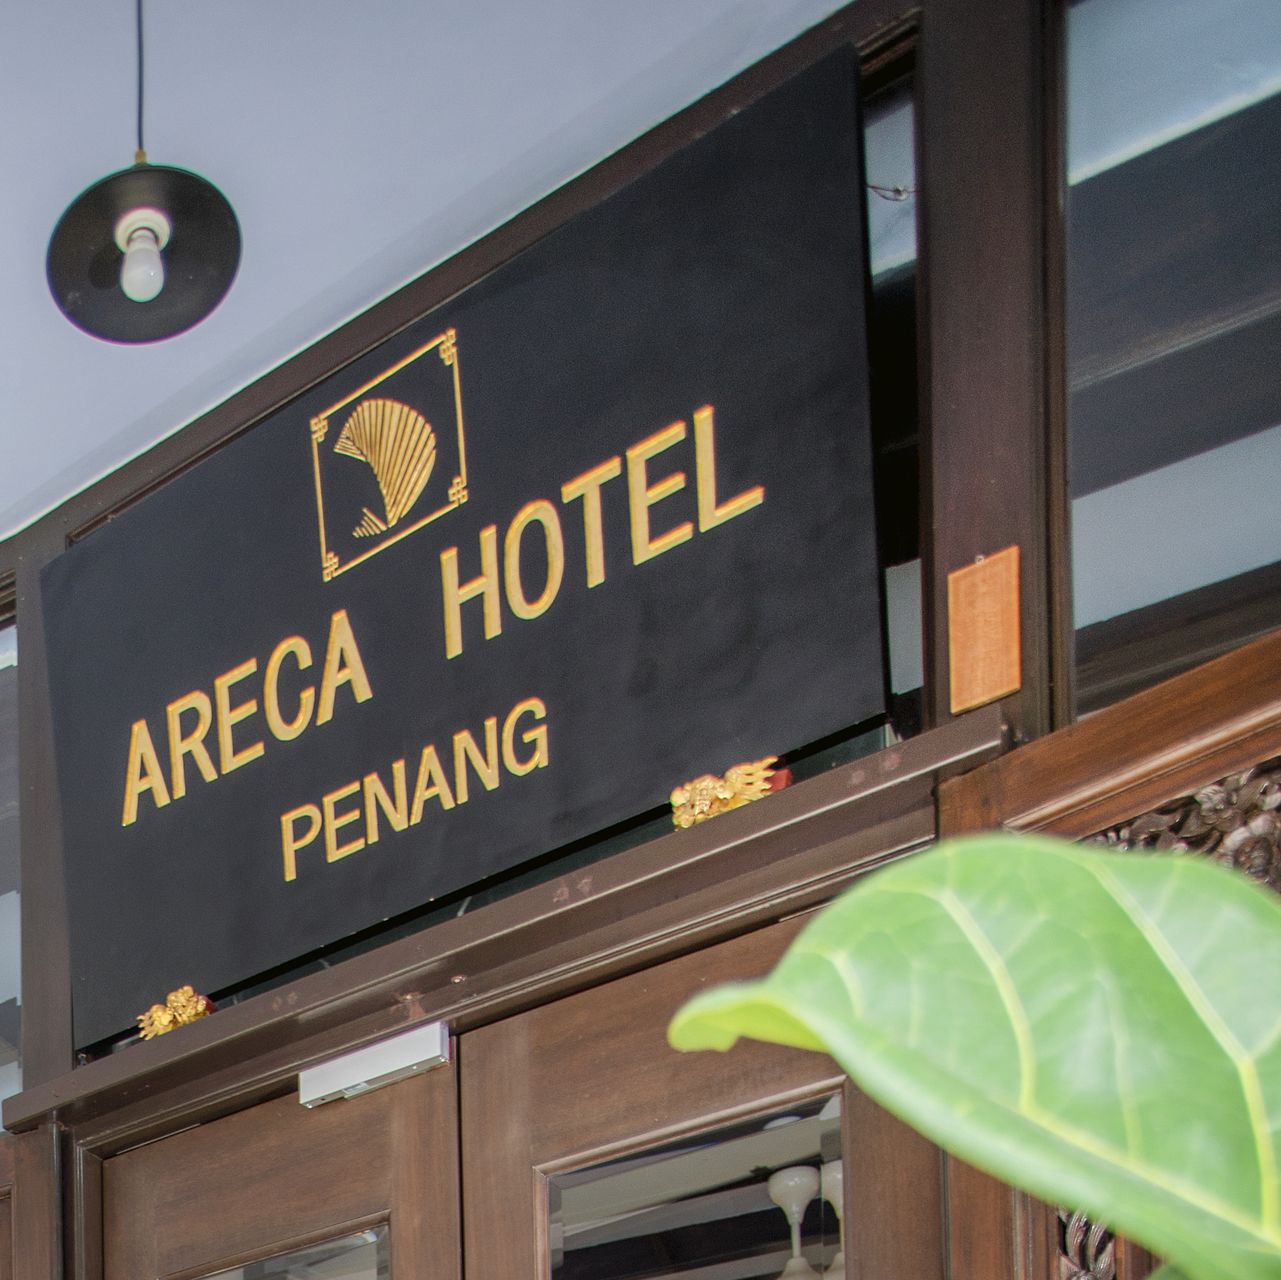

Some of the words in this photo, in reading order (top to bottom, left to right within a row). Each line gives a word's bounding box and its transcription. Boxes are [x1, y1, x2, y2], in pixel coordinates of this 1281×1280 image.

[121, 608, 373, 826] ARECA
[439, 403, 765, 660] HOTEL
[280, 696, 550, 881] PENANG
